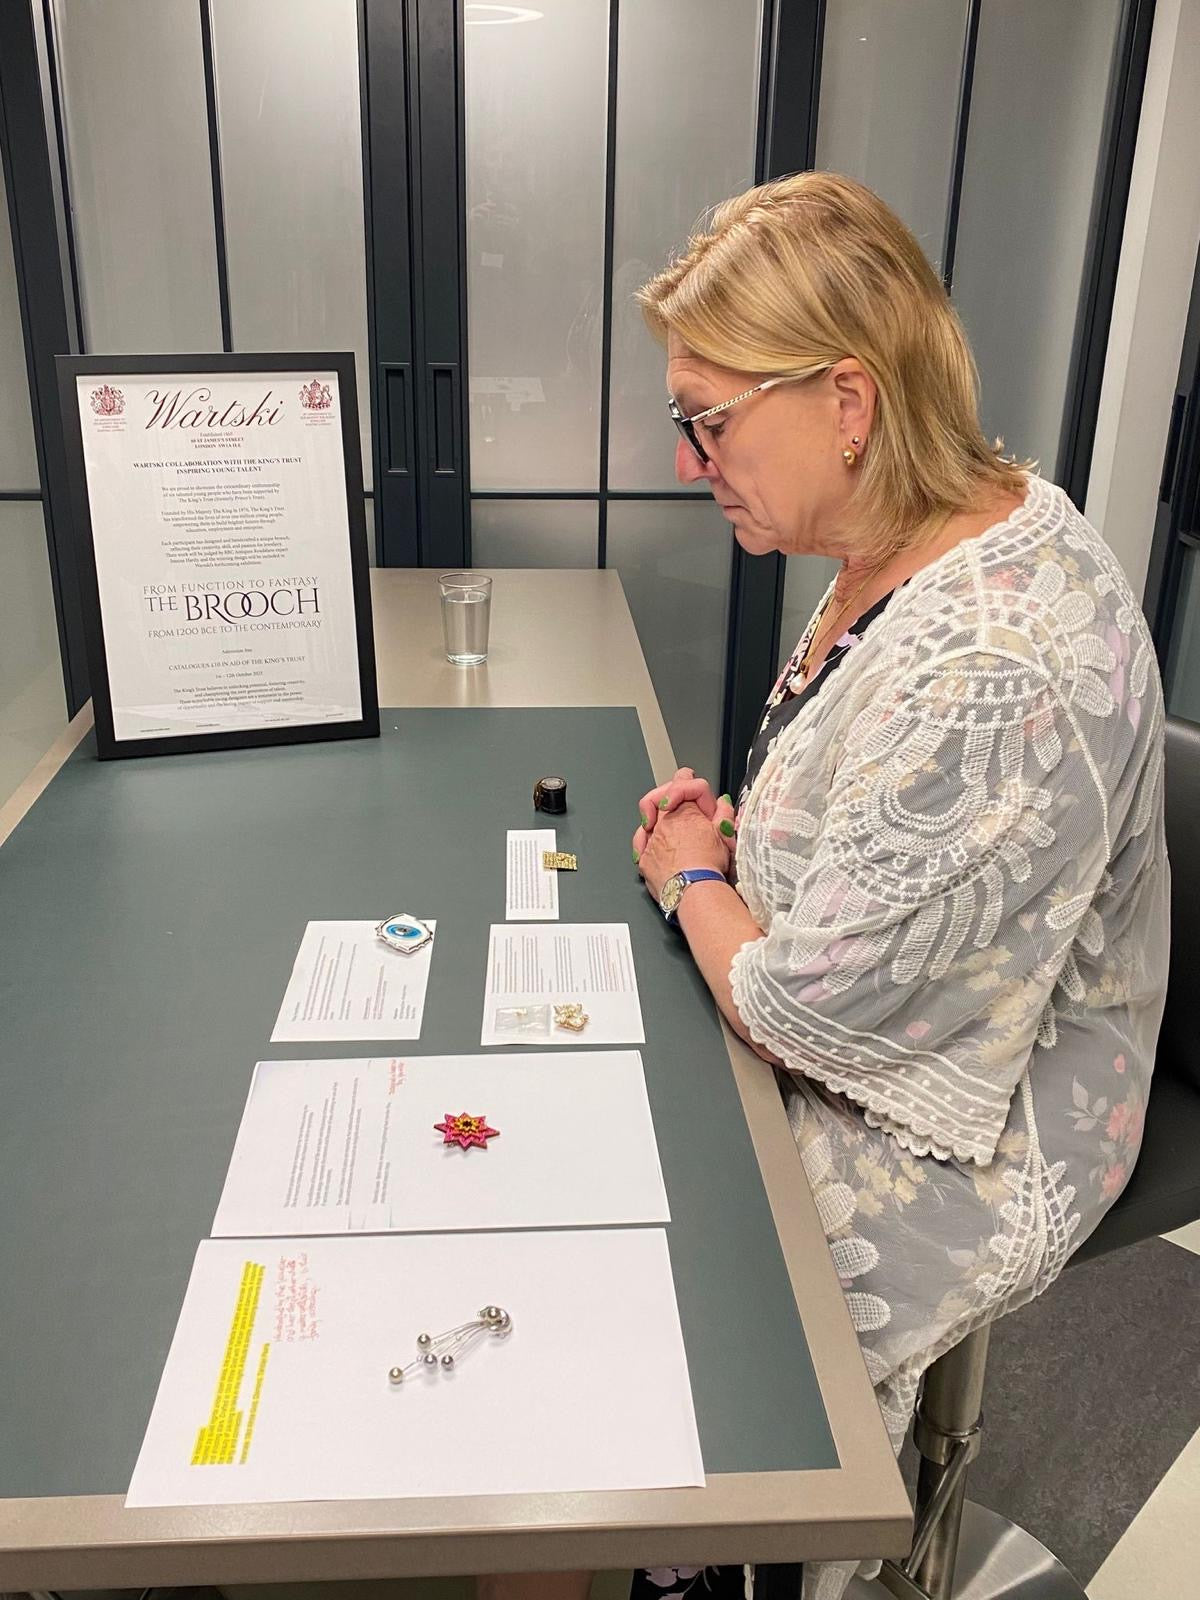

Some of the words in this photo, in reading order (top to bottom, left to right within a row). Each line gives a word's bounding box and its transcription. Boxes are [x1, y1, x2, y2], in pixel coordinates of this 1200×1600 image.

[144, 387, 284, 430] Wartski
[144, 585, 177, 595] FROM
[182, 580, 244, 592] FUNCTION
[248, 578, 265, 588] TO
[269, 576, 318, 587] FANTASY
[144, 596, 178, 612] THE
[184, 588, 320, 624] BROOCH
[148, 630, 174, 638] FROM
[176, 628, 198, 636] 1200
[250, 620, 322, 631] CONTEMPORARY
